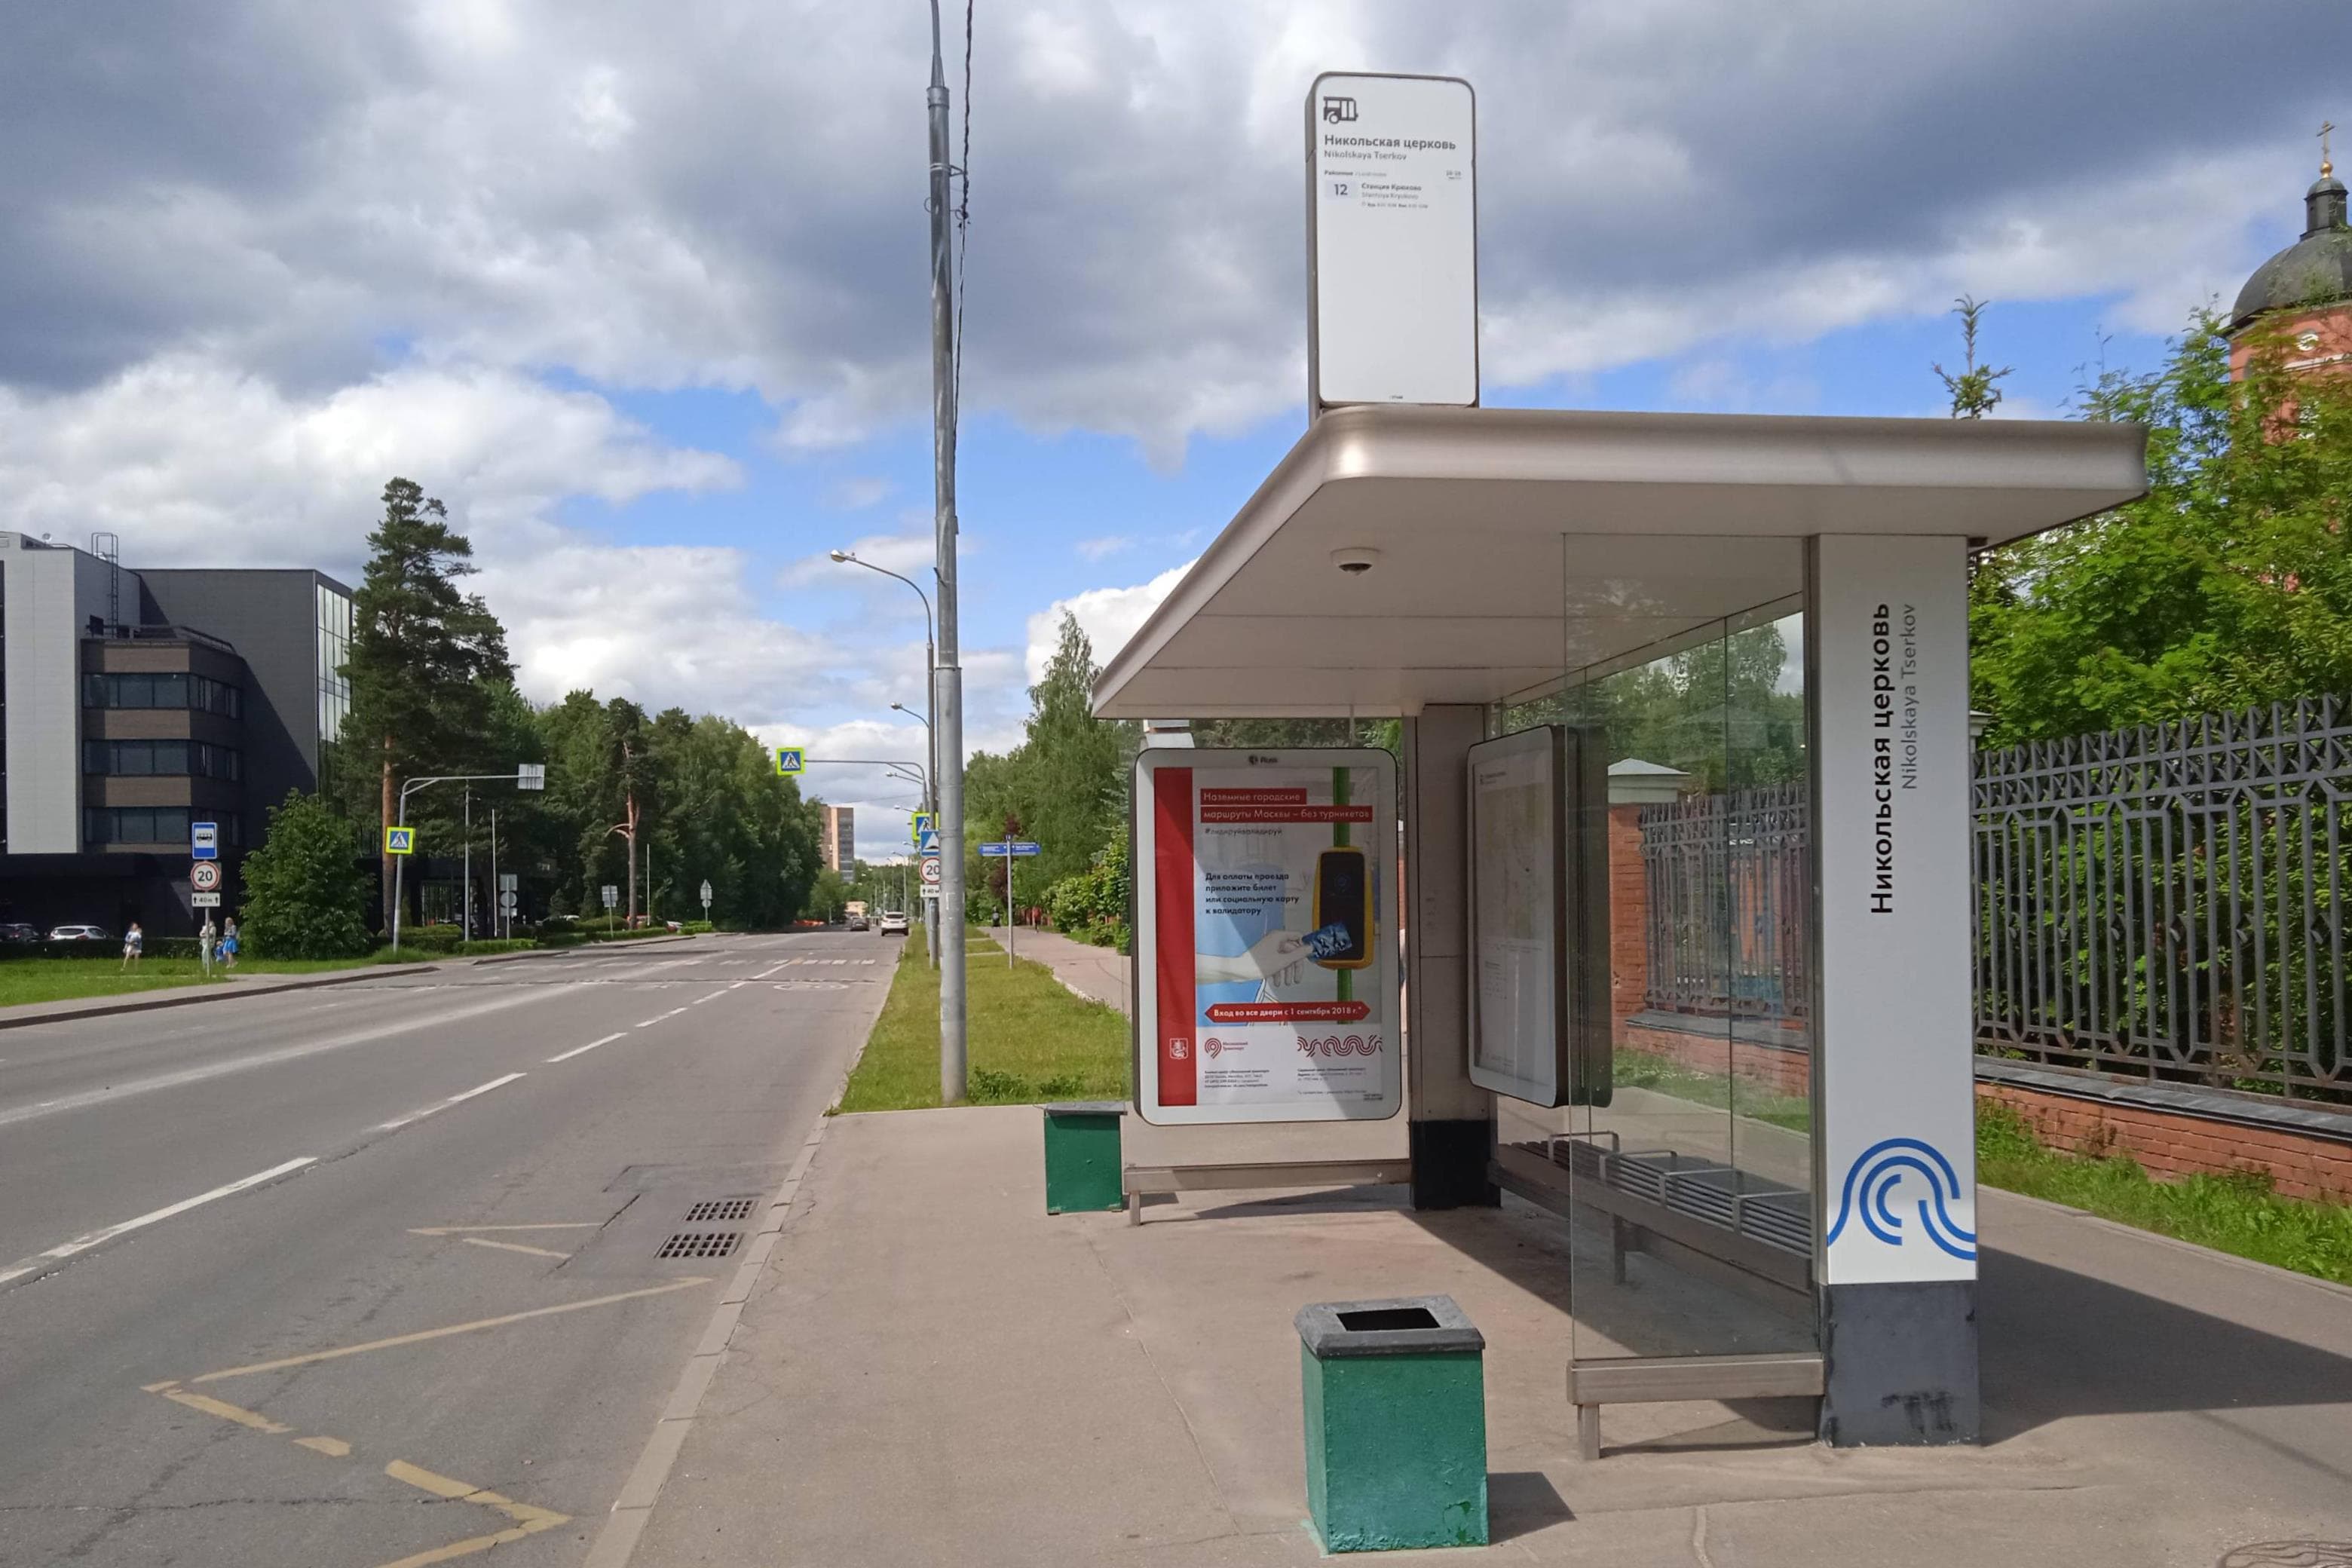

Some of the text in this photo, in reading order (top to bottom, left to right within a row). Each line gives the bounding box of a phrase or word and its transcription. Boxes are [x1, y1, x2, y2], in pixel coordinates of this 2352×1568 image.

[1324, 134, 1456, 151] Никольская церковь
[1324, 150, 1407, 161] Nikolskaya Tserkov
[1334, 183, 1349, 196] 12
[1900, 604, 1921, 790] Nikolskaya Tserkov
[1870, 603, 1895, 914] Никольская церковь
[1203, 792, 1300, 804] Наземные городские
[1204, 811, 1251, 820] маршруты
[1254, 810, 1291, 819] Москвы
[1300, 809, 1317, 818] без
[1319, 810, 1370, 820] турникетов
[926, 865, 941, 875] 20
[198, 870, 213, 882] 20
[1205, 872, 1220, 881] Для
[1205, 884, 1277, 893] приложите билет
[1223, 896, 1274, 905] социальную
[1275, 896, 1300, 905] карту
[1212, 908, 1262, 916] валидатору
[1214, 1009, 1234, 1018] Вход
[1260, 1009, 1282, 1018] двери
[1297, 1006, 1331, 1016] сентября
[1331, 1006, 1352, 1015] 2018
